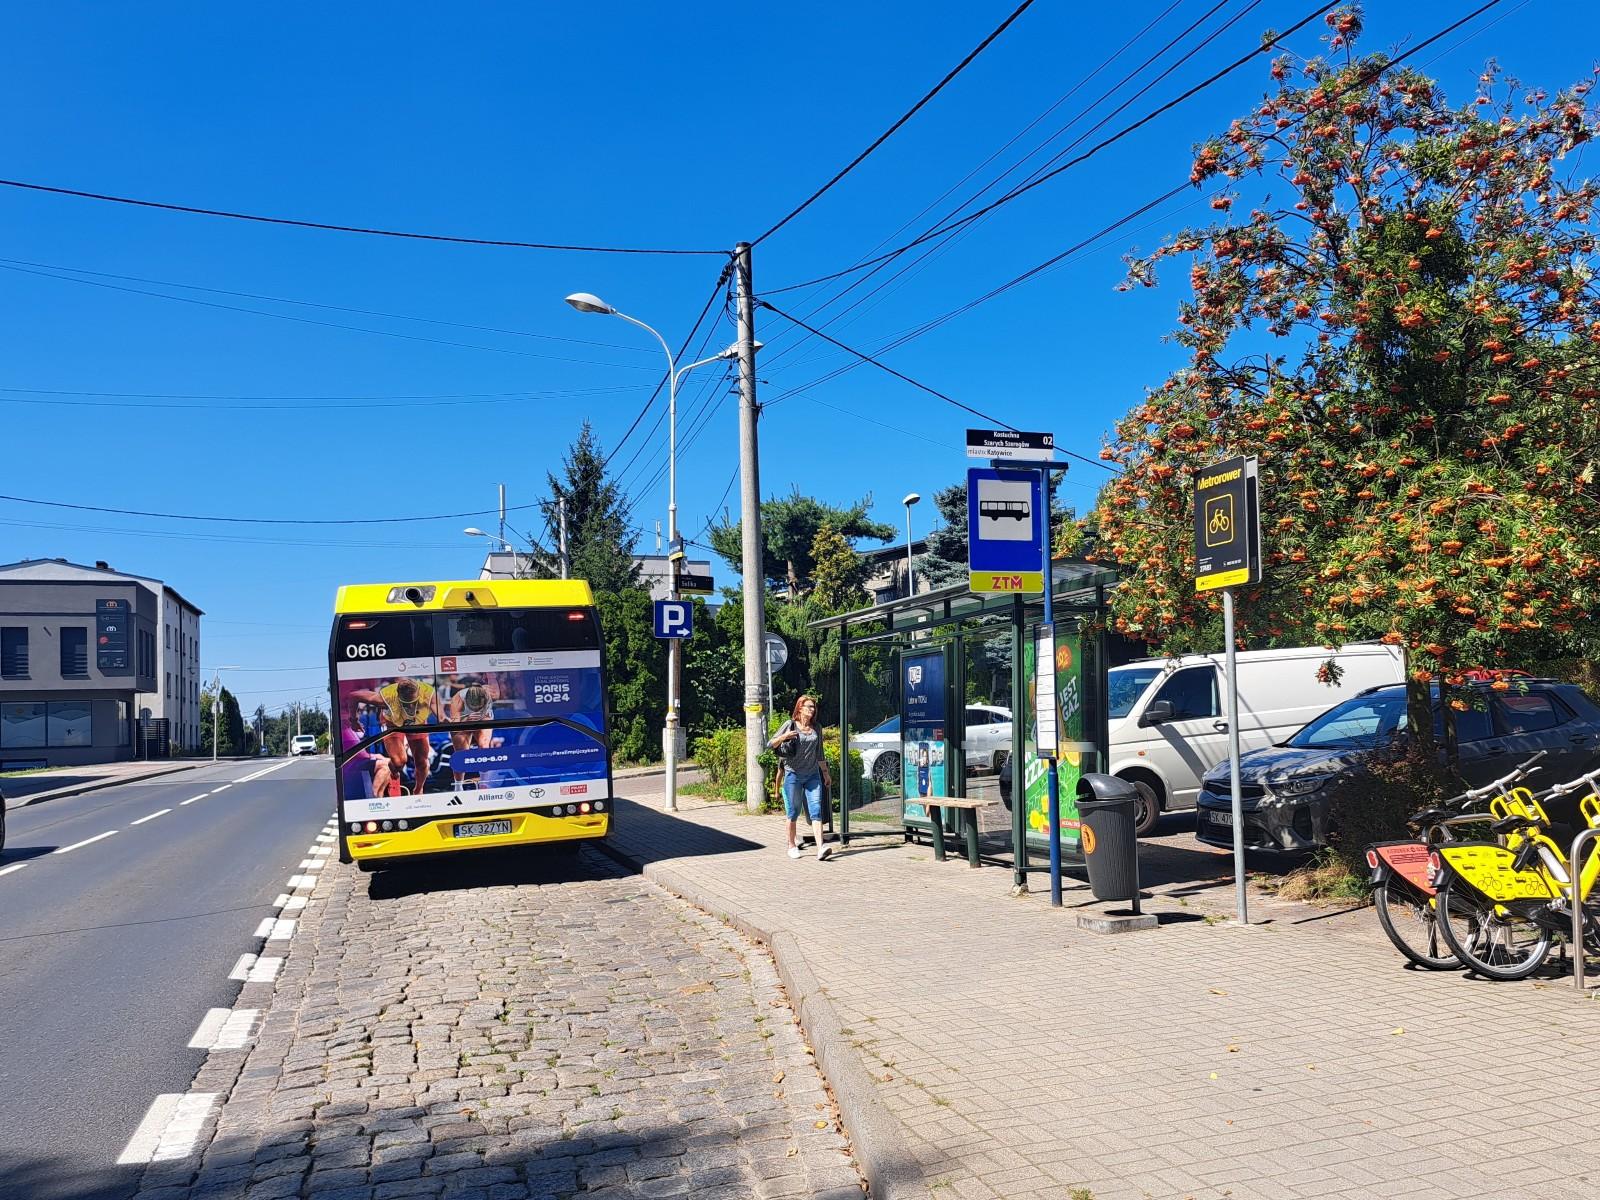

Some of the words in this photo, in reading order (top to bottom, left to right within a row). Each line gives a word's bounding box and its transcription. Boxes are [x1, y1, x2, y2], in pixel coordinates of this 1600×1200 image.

[1042, 435, 1053, 446] 02
[987, 449, 1013, 457] Katowice
[1197, 468, 1242, 490] Metrorower
[991, 576, 1023, 590] ZTM
[663, 604, 685, 634] P
[346, 643, 387, 659] 0616
[534, 683, 570, 694] PARIS
[1060, 675, 1077, 706] JEST
[535, 692, 571, 704] 2024
[1062, 691, 1080, 722] GAZ
[478, 793, 503, 801] Allianz
[461, 826, 474, 835] SK
[478, 822, 509, 834] 327YN
